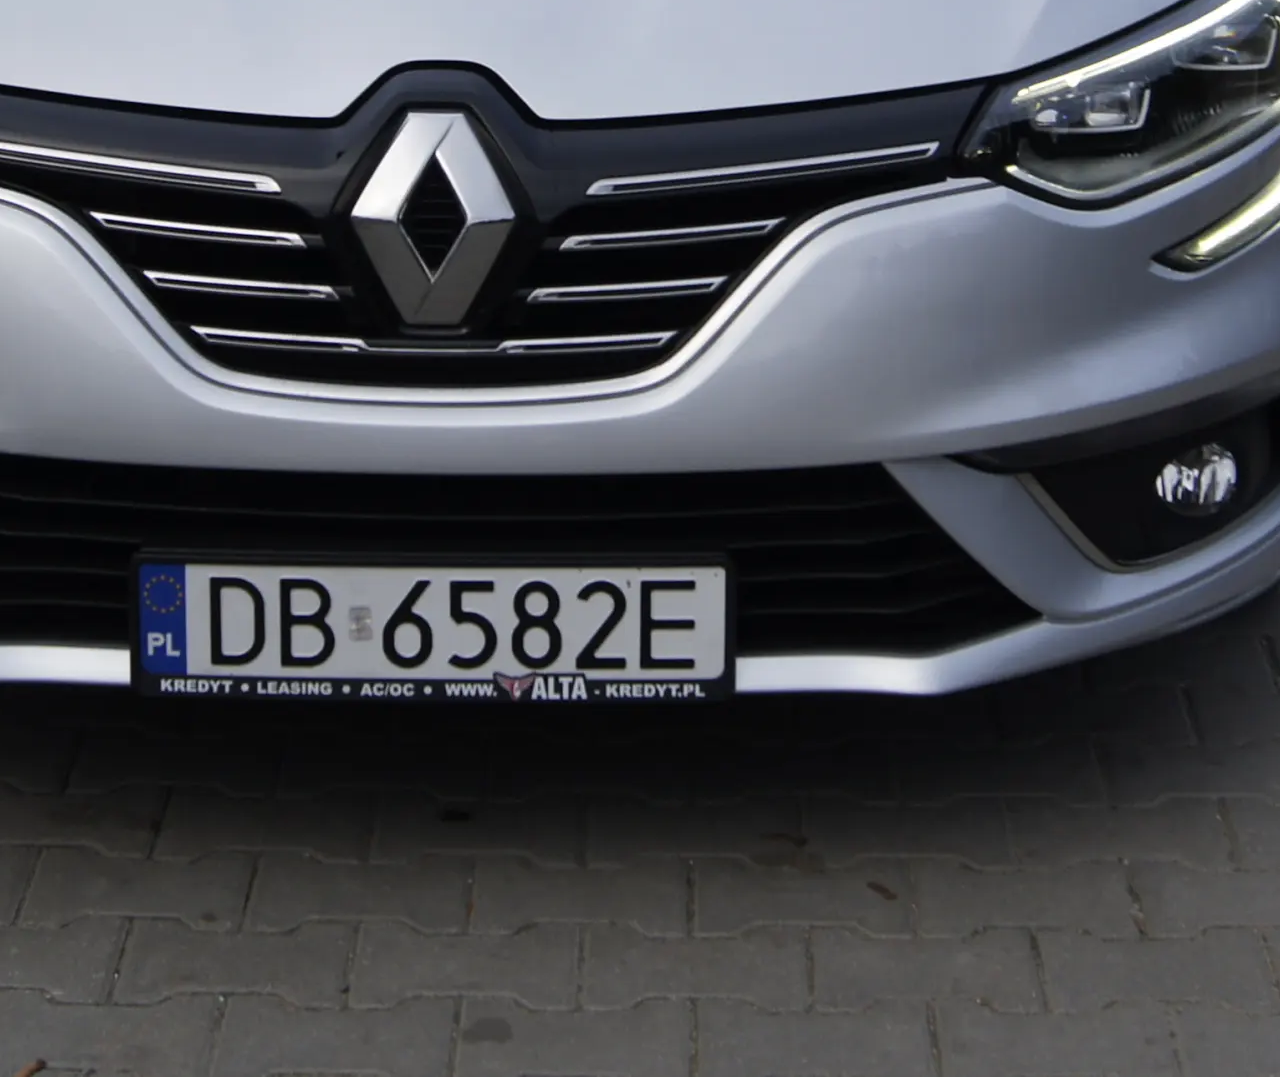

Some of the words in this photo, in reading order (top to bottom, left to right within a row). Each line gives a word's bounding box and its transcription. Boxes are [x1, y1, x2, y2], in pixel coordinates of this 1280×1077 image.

[209, 576, 336, 668] DB
[382, 579, 696, 670] 6582E
[147, 632, 181, 657] PL
[160, 678, 233, 694] KREDYT
[256, 681, 333, 696] LEASING
[360, 683, 415, 697] AC/OC
[531, 676, 588, 700] ALTA
[605, 683, 706, 698] KREDYT.PL
